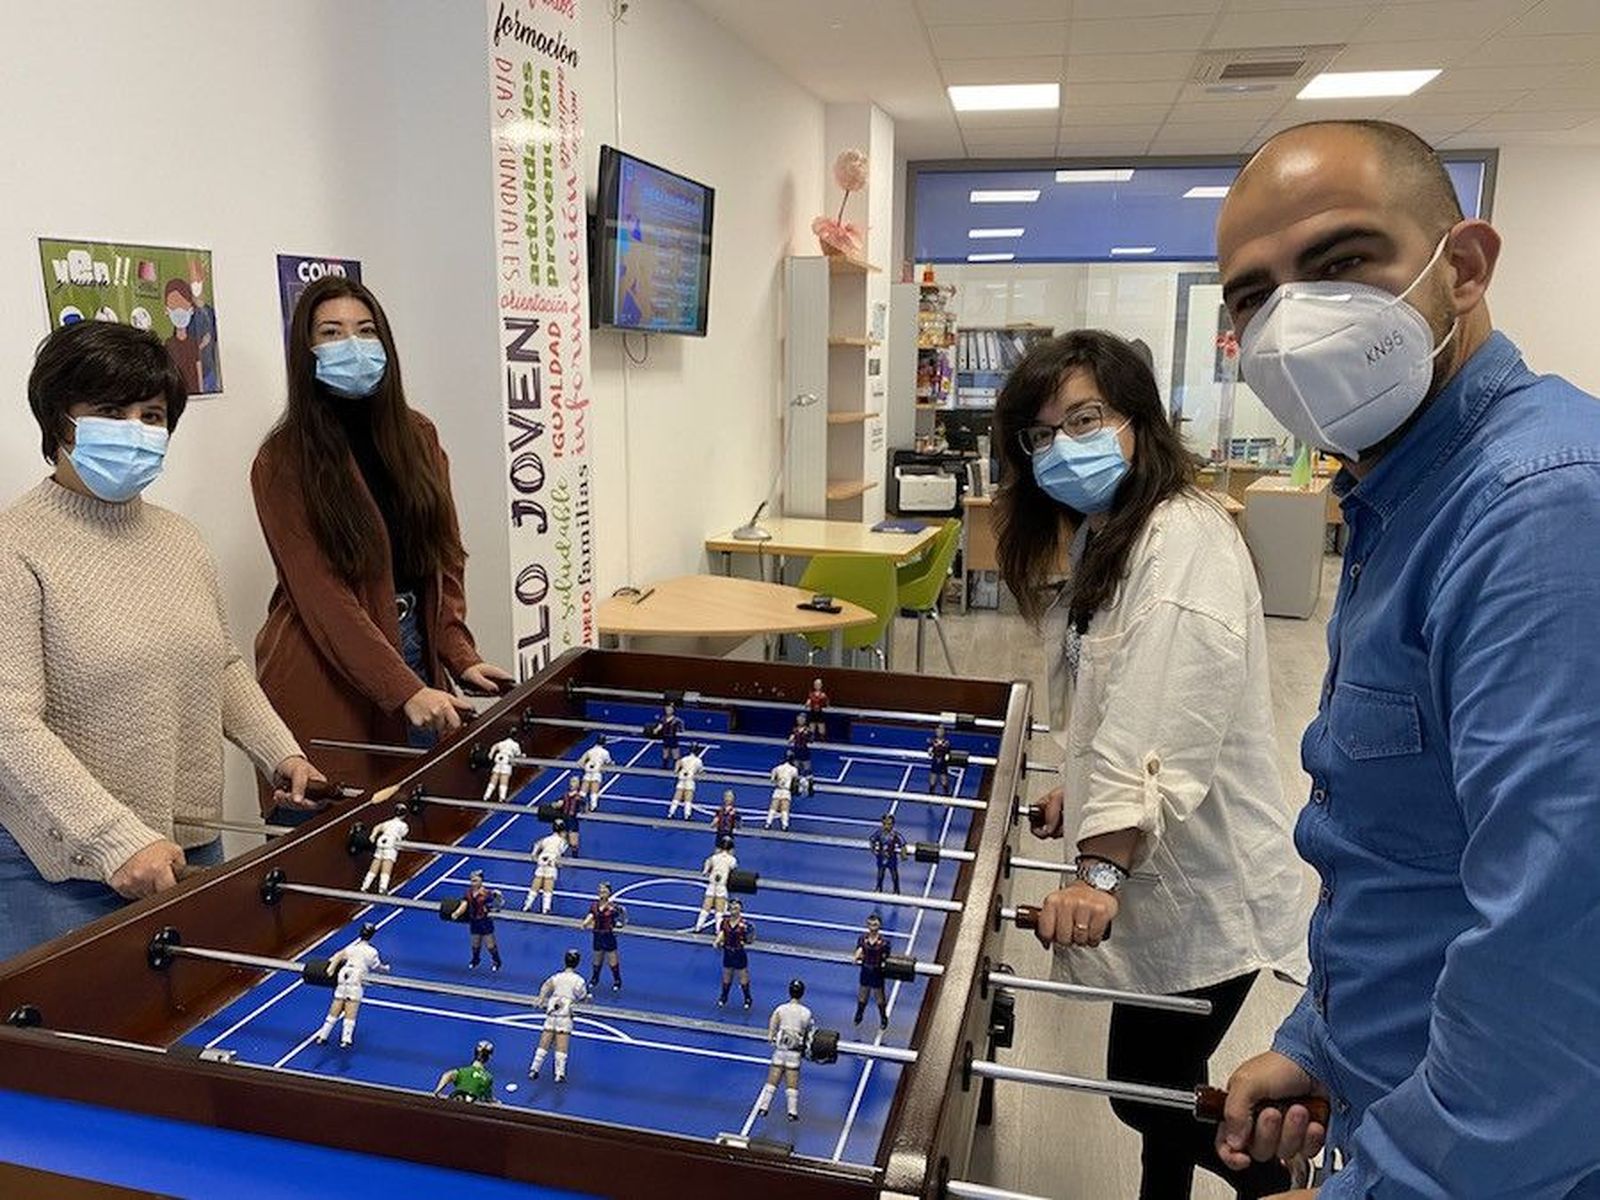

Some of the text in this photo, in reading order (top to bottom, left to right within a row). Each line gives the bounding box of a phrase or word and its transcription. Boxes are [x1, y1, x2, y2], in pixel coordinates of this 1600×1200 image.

[493, 2, 578, 68] formación
[547, 321, 566, 459] IGUALDAD
[1363, 328, 1405, 367] KN95
[503, 316, 548, 534] JOVEN
[550, 474, 573, 621] saludable
[573, 464, 592, 586] familias
